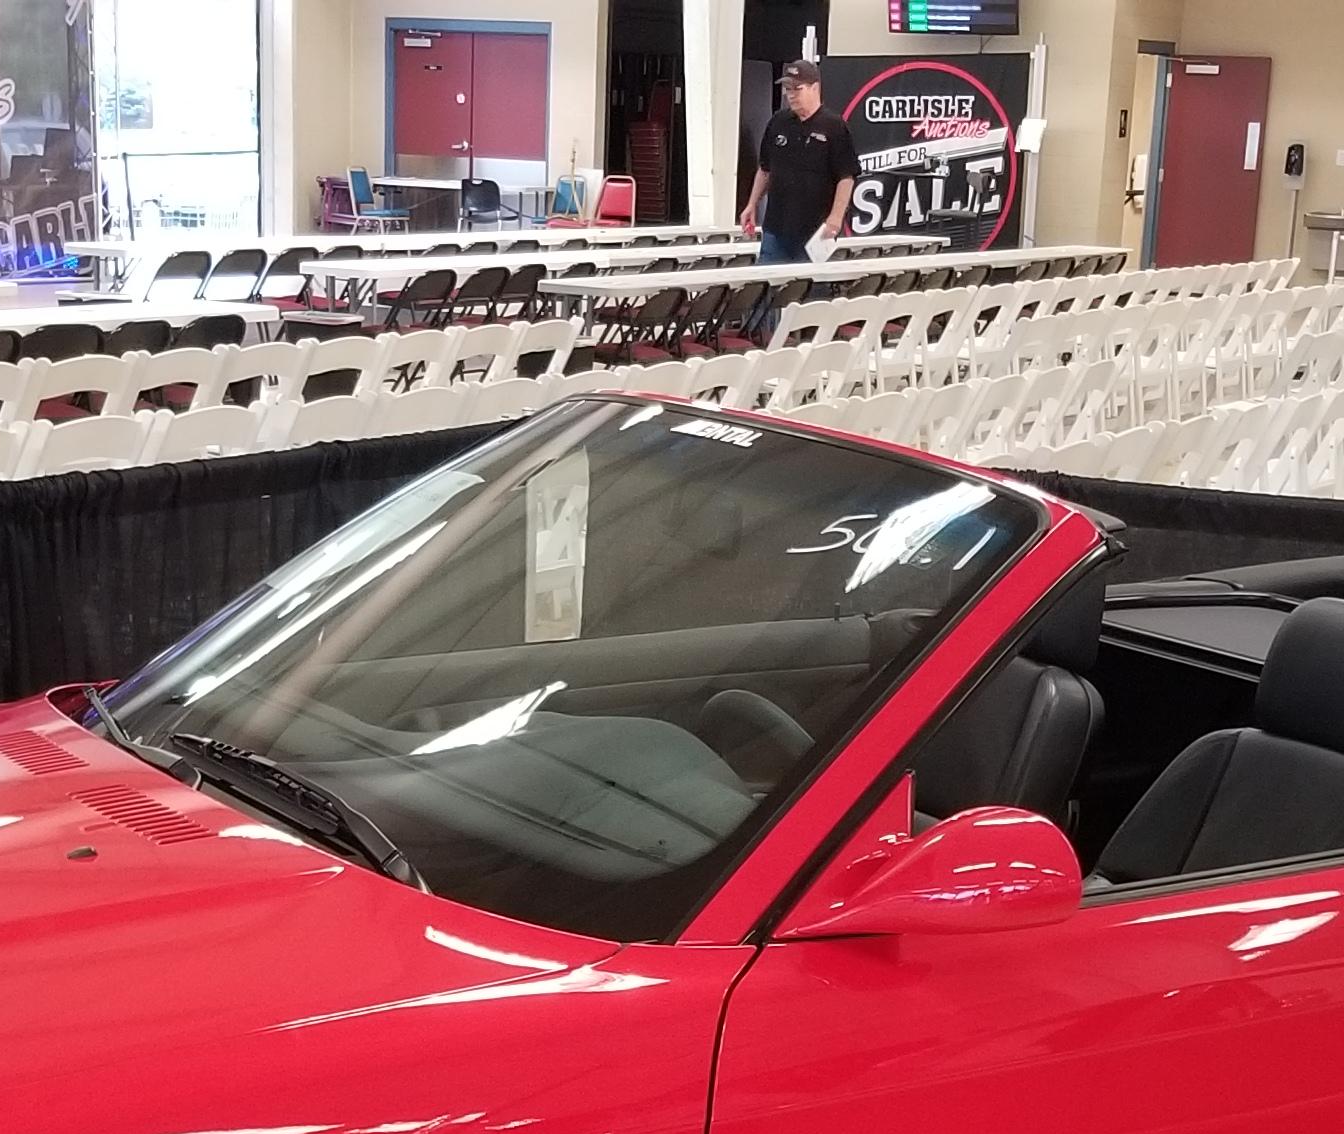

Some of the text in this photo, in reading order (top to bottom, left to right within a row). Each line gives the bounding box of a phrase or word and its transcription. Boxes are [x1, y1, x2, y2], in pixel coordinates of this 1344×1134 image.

[866, 96, 975, 122] CARLISLE
[858, 147, 927, 174] TILL FOR
[852, 157, 1004, 234] SALE
